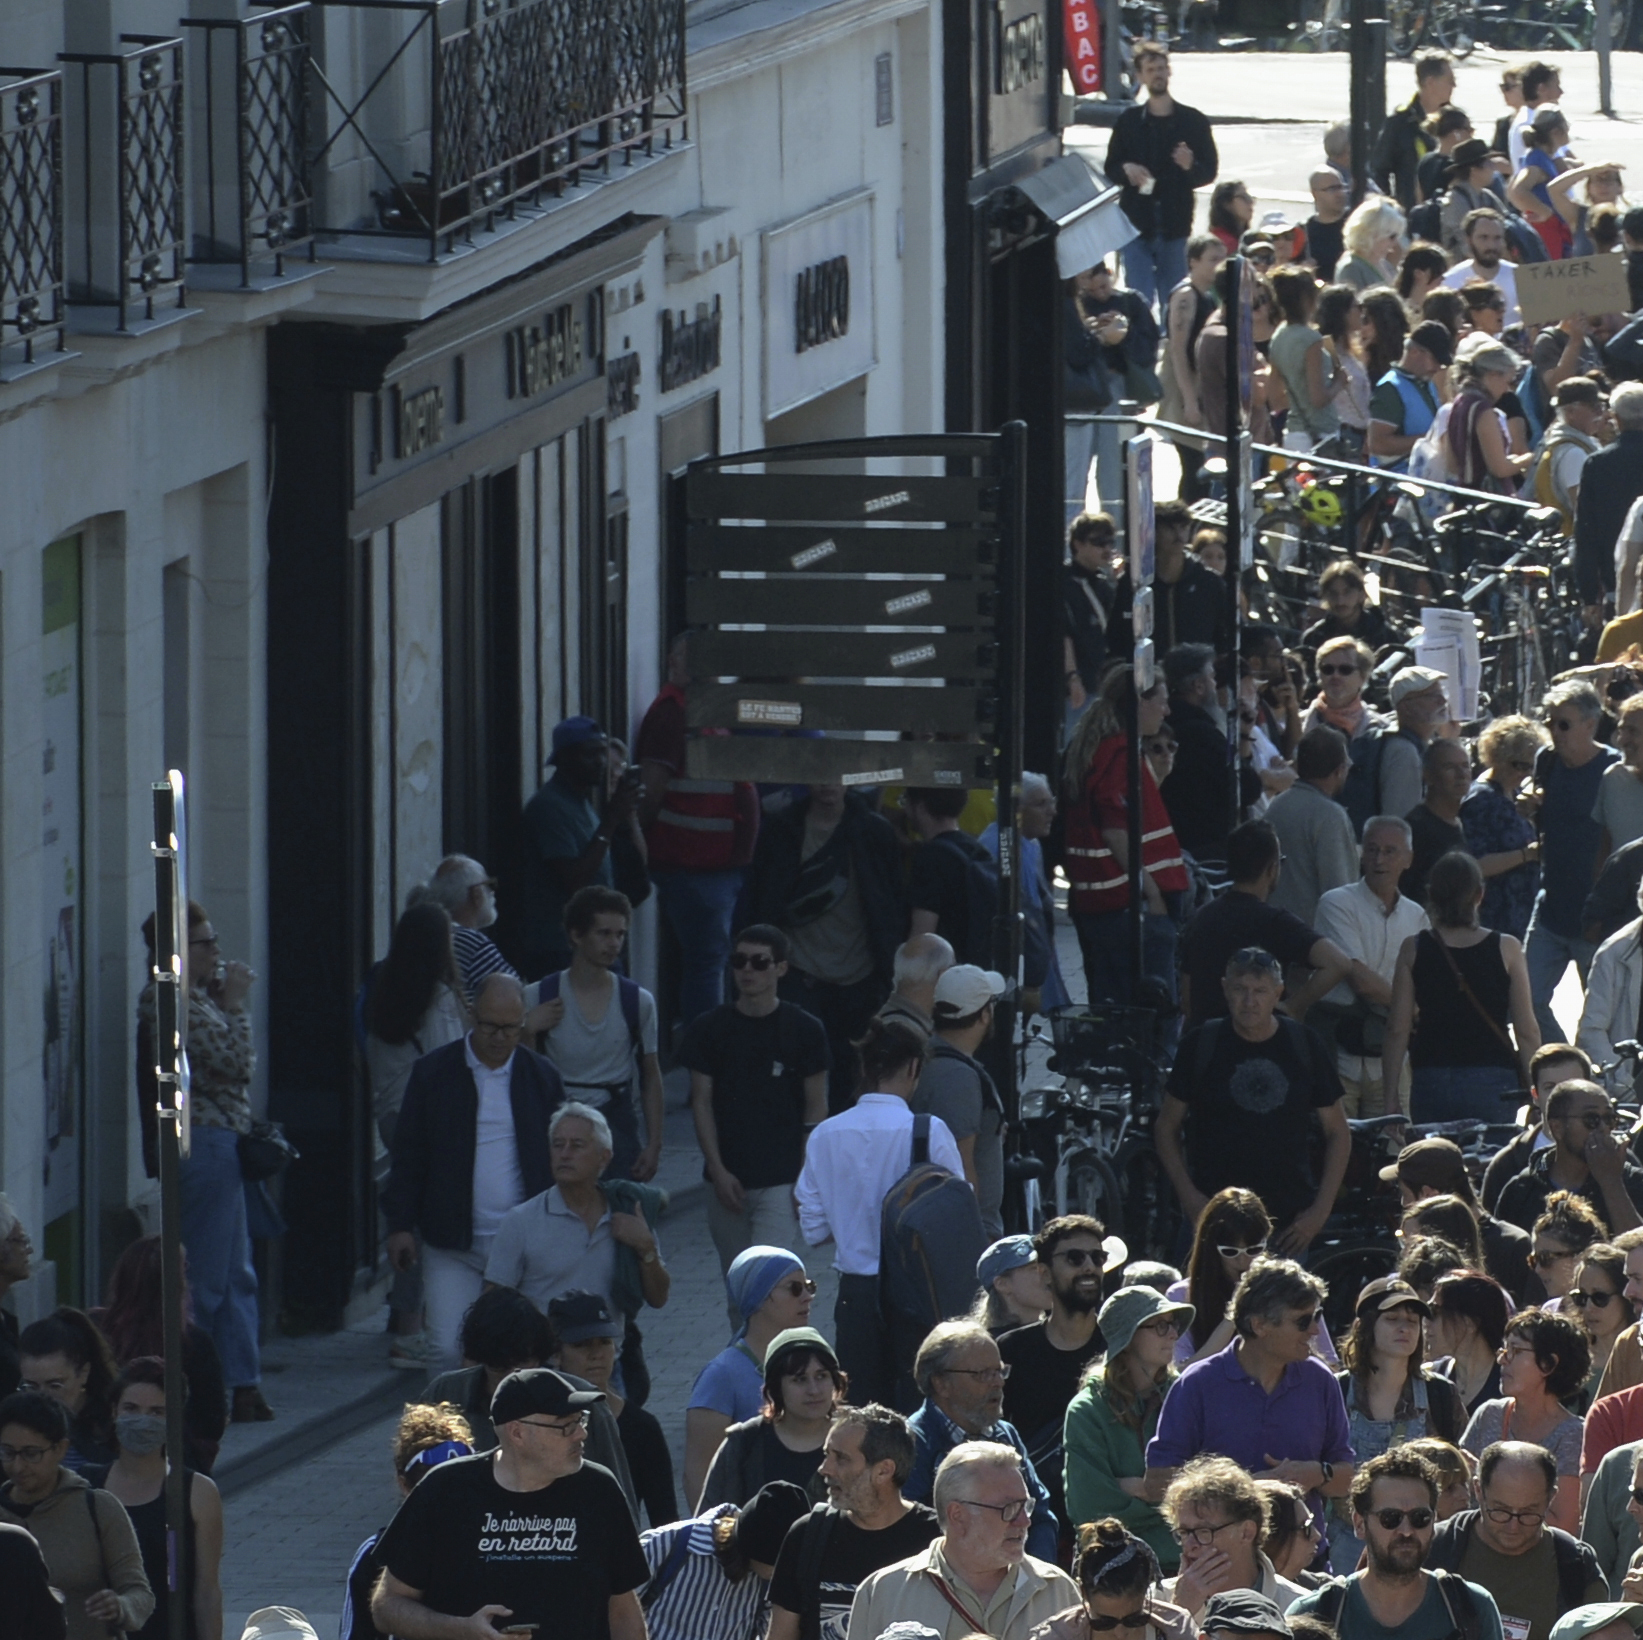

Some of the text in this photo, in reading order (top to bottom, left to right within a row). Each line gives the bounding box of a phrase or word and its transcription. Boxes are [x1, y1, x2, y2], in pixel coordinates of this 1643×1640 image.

[1530, 260, 1597, 279] TAXER
[481, 1512, 500, 1533] Je
[552, 1517, 577, 1536] pas
[478, 1530, 578, 1552] en retard
